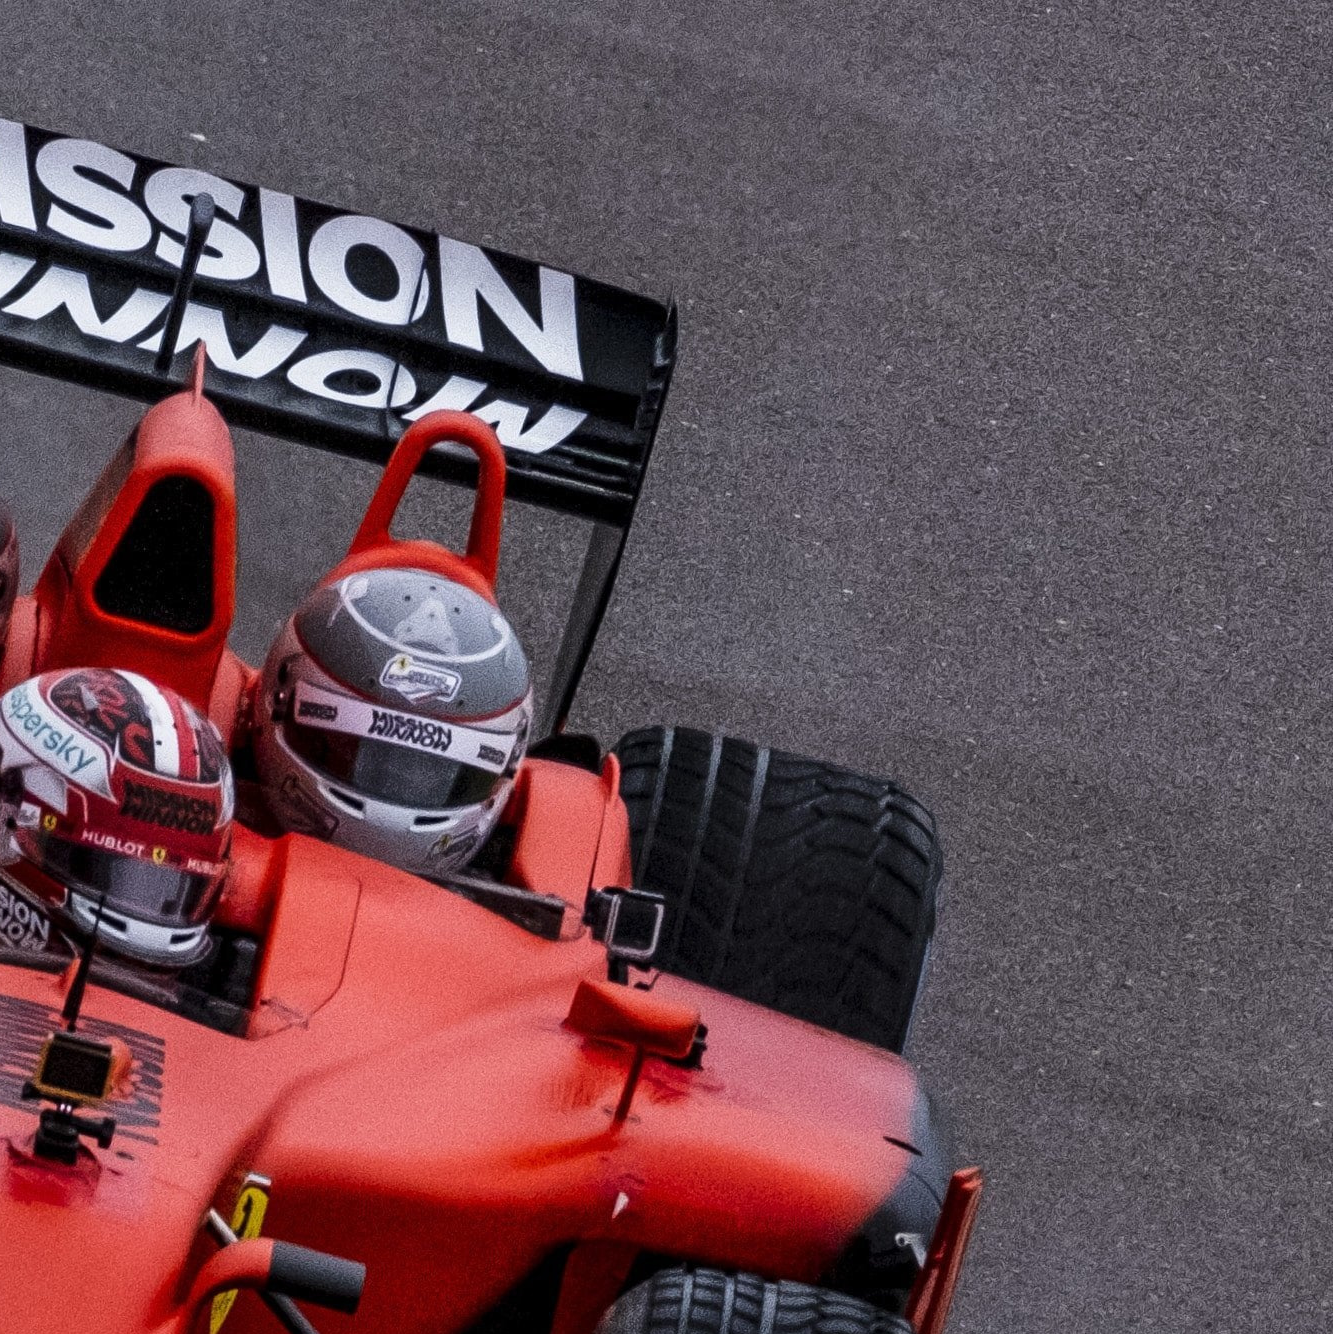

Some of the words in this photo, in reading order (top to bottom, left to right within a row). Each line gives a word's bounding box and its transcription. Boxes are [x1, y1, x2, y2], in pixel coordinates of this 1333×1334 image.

[368, 723, 452, 752] WINNOW
[372, 709, 452, 741] MISSION
[81, 829, 145, 857] HUBLOT
